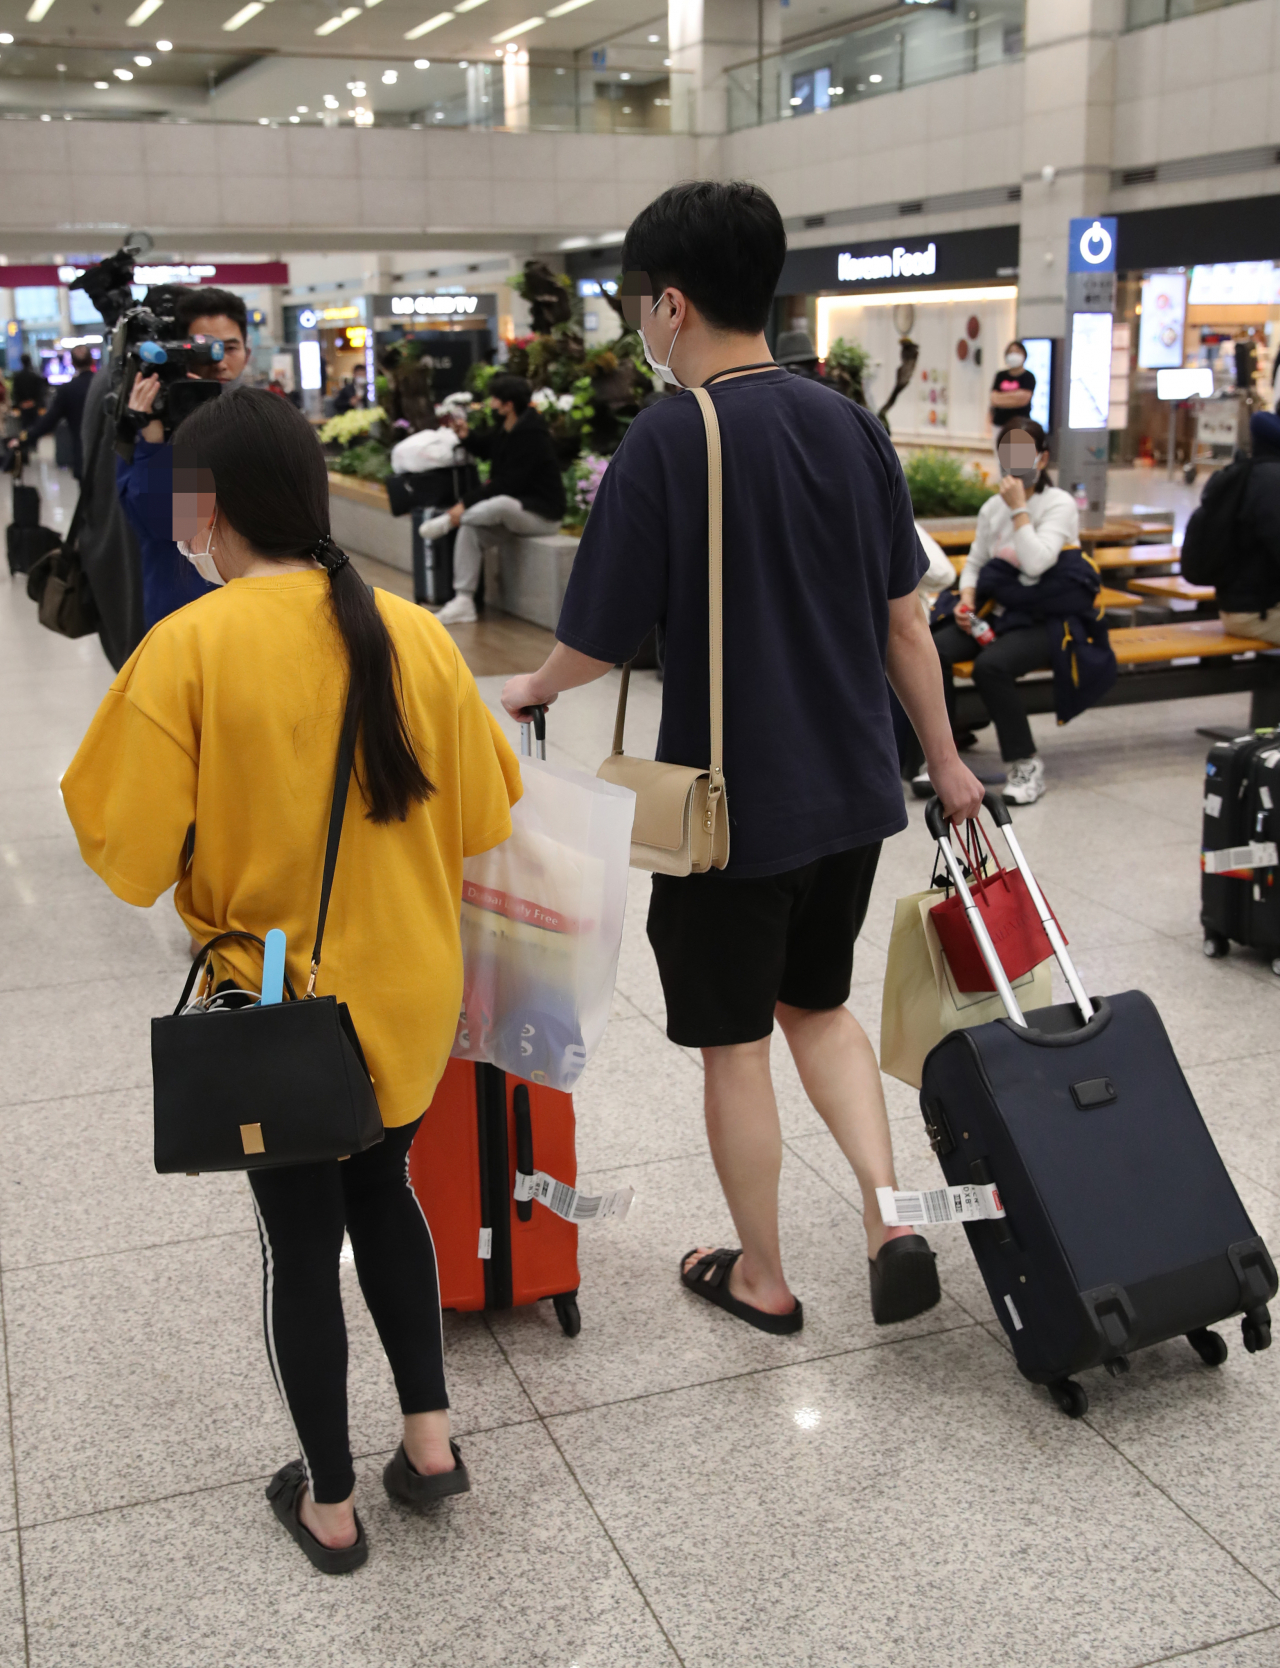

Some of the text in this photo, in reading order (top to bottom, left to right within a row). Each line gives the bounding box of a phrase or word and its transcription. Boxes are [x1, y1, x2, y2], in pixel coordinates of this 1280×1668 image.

[838, 242, 936, 281] Korean Food
[392, 296, 478, 314] LG OLED TV
[467, 887, 559, 926] Dbai ty Free
